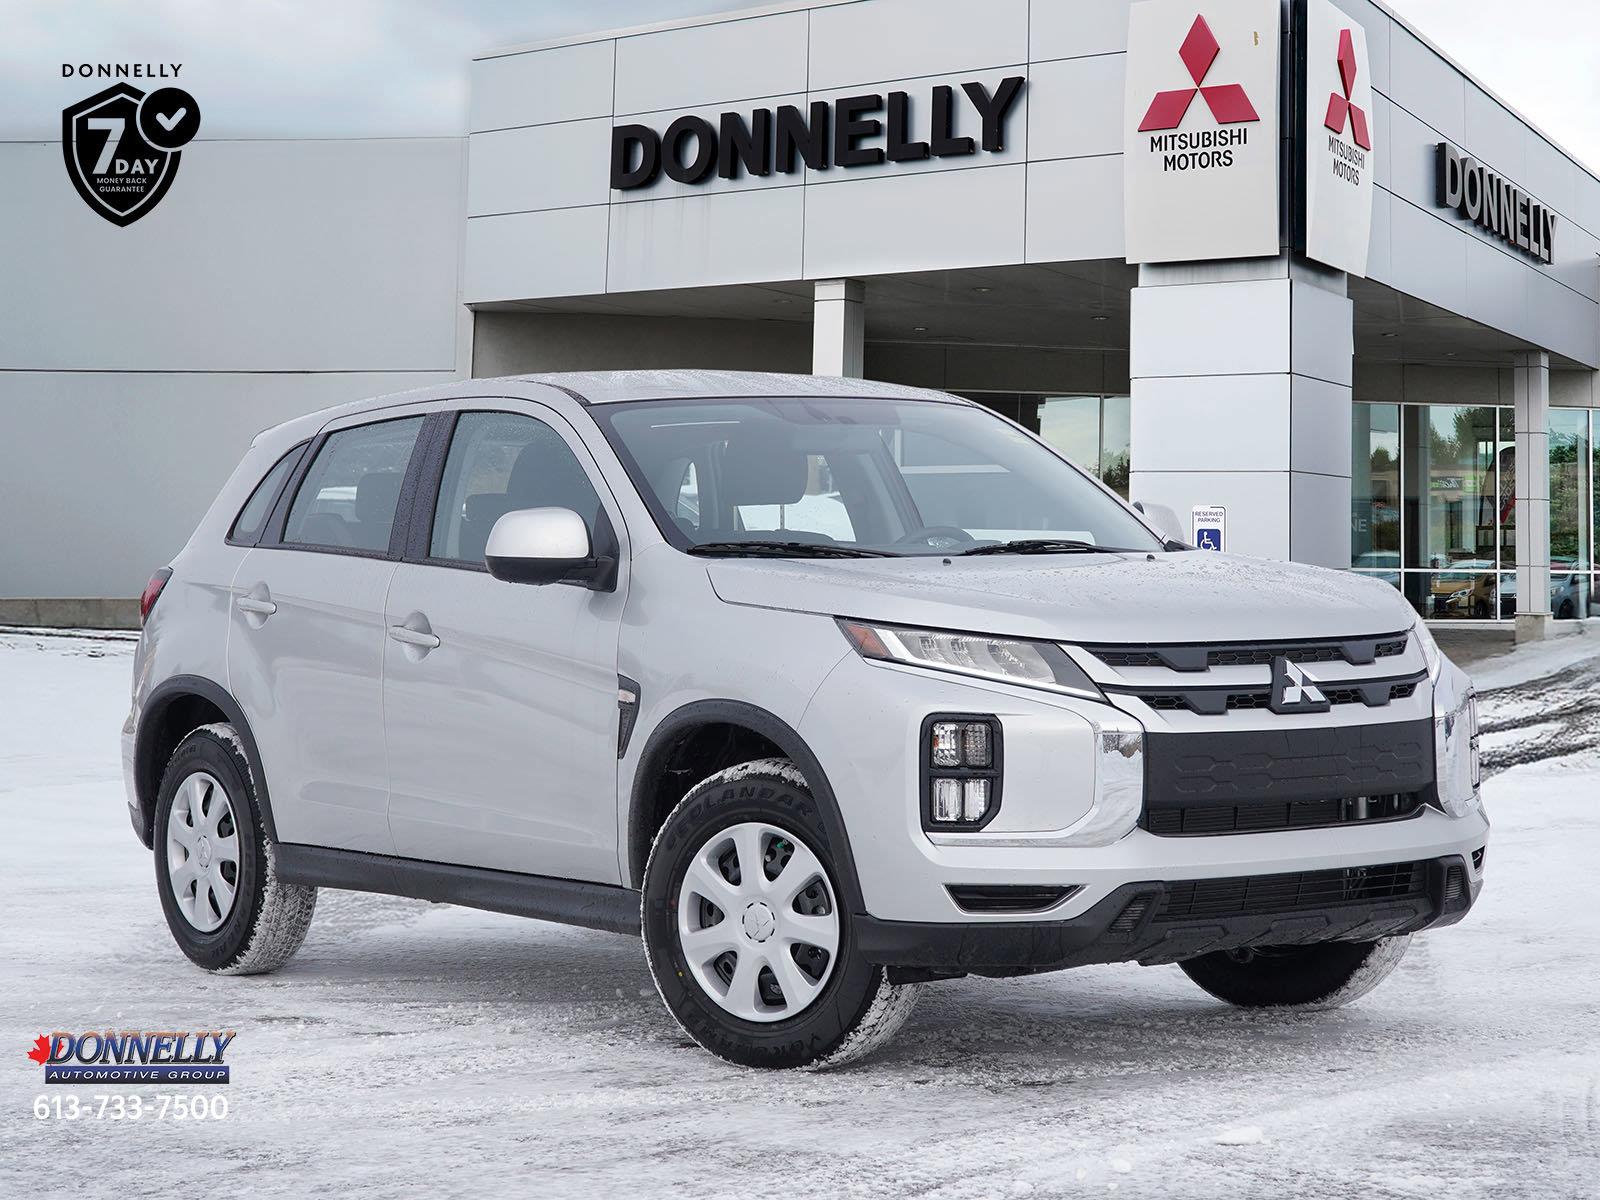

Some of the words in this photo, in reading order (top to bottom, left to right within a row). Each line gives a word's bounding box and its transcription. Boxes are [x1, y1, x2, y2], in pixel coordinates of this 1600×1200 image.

[611, 76, 1025, 190] DONNELLY
[1150, 127, 1248, 153] MITSUBISHI
[1163, 149, 1234, 172] MOTORS
[1328, 135, 1365, 170] MITSUBISHI
[1333, 159, 1360, 186] MOTORS
[1436, 142, 1558, 265] DONNELLY
